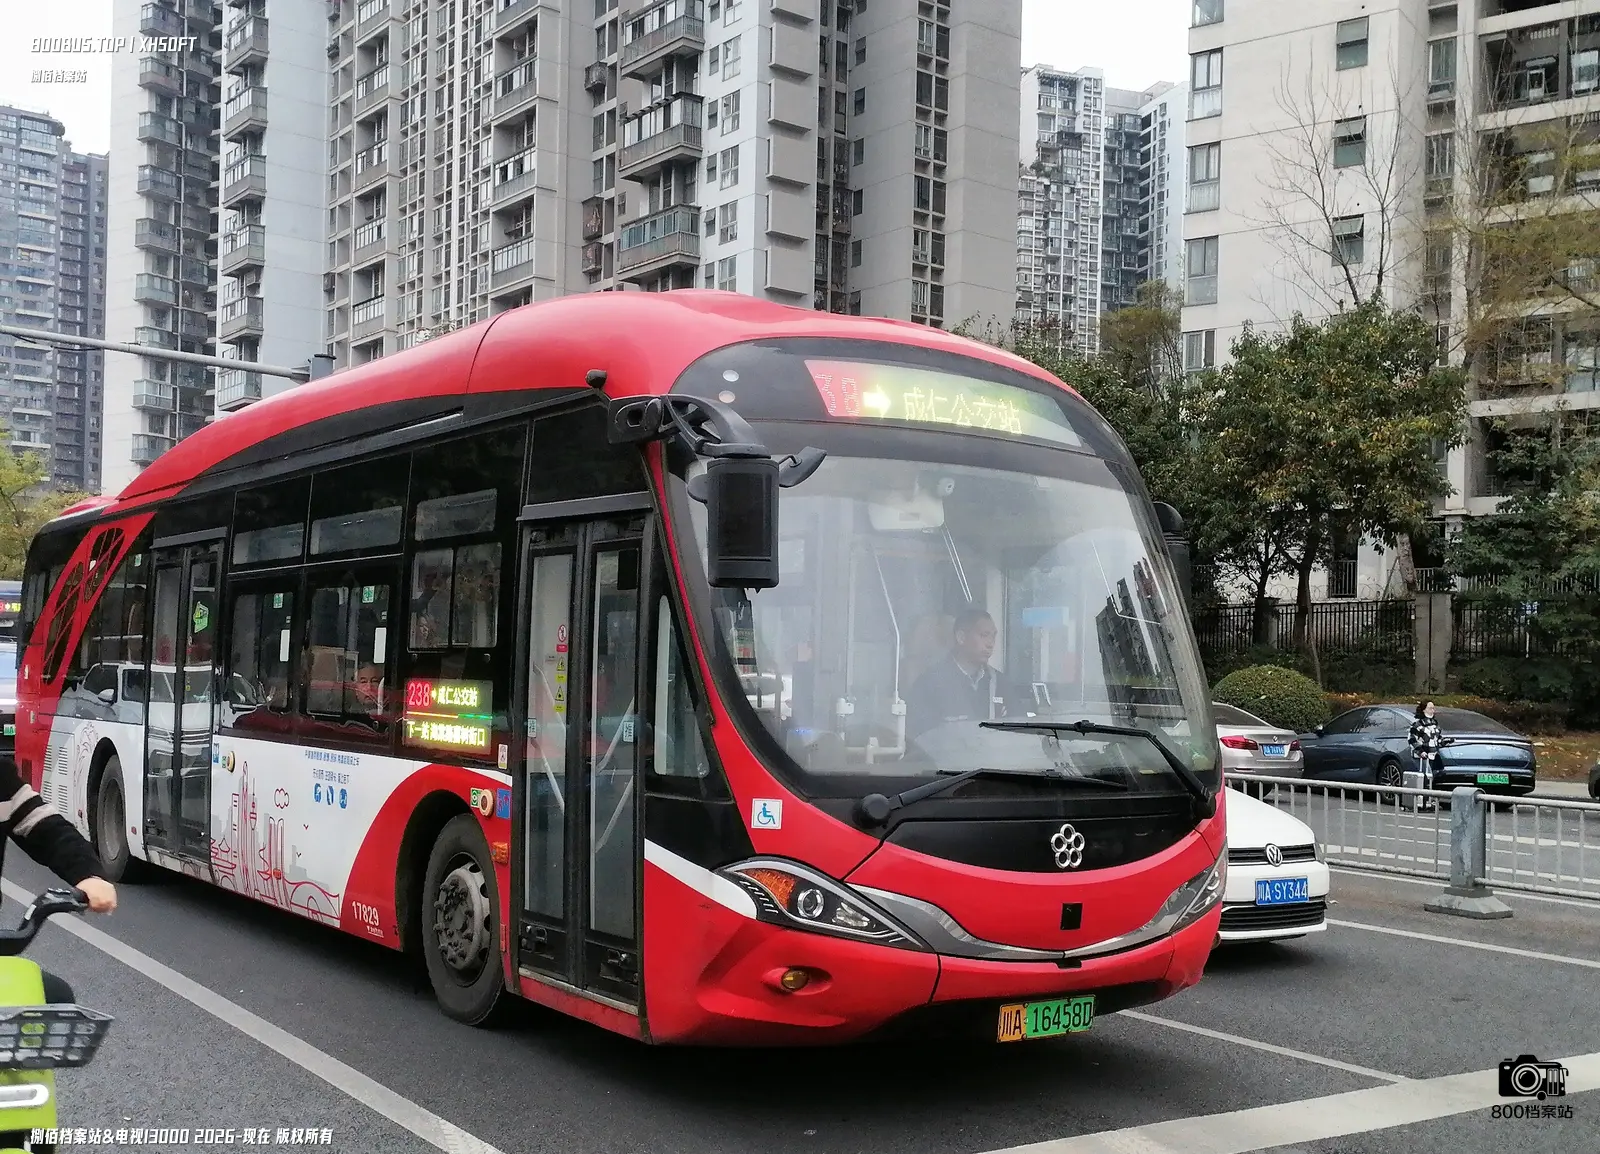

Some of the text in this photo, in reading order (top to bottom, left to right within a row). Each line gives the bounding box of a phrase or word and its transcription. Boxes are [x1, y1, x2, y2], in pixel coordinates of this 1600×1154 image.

[903, 387, 1023, 434] 成仁公交站
[407, 682, 430, 707] 238
[437, 686, 478, 707] 成仁公交站
[352, 901, 379, 926] 17829
